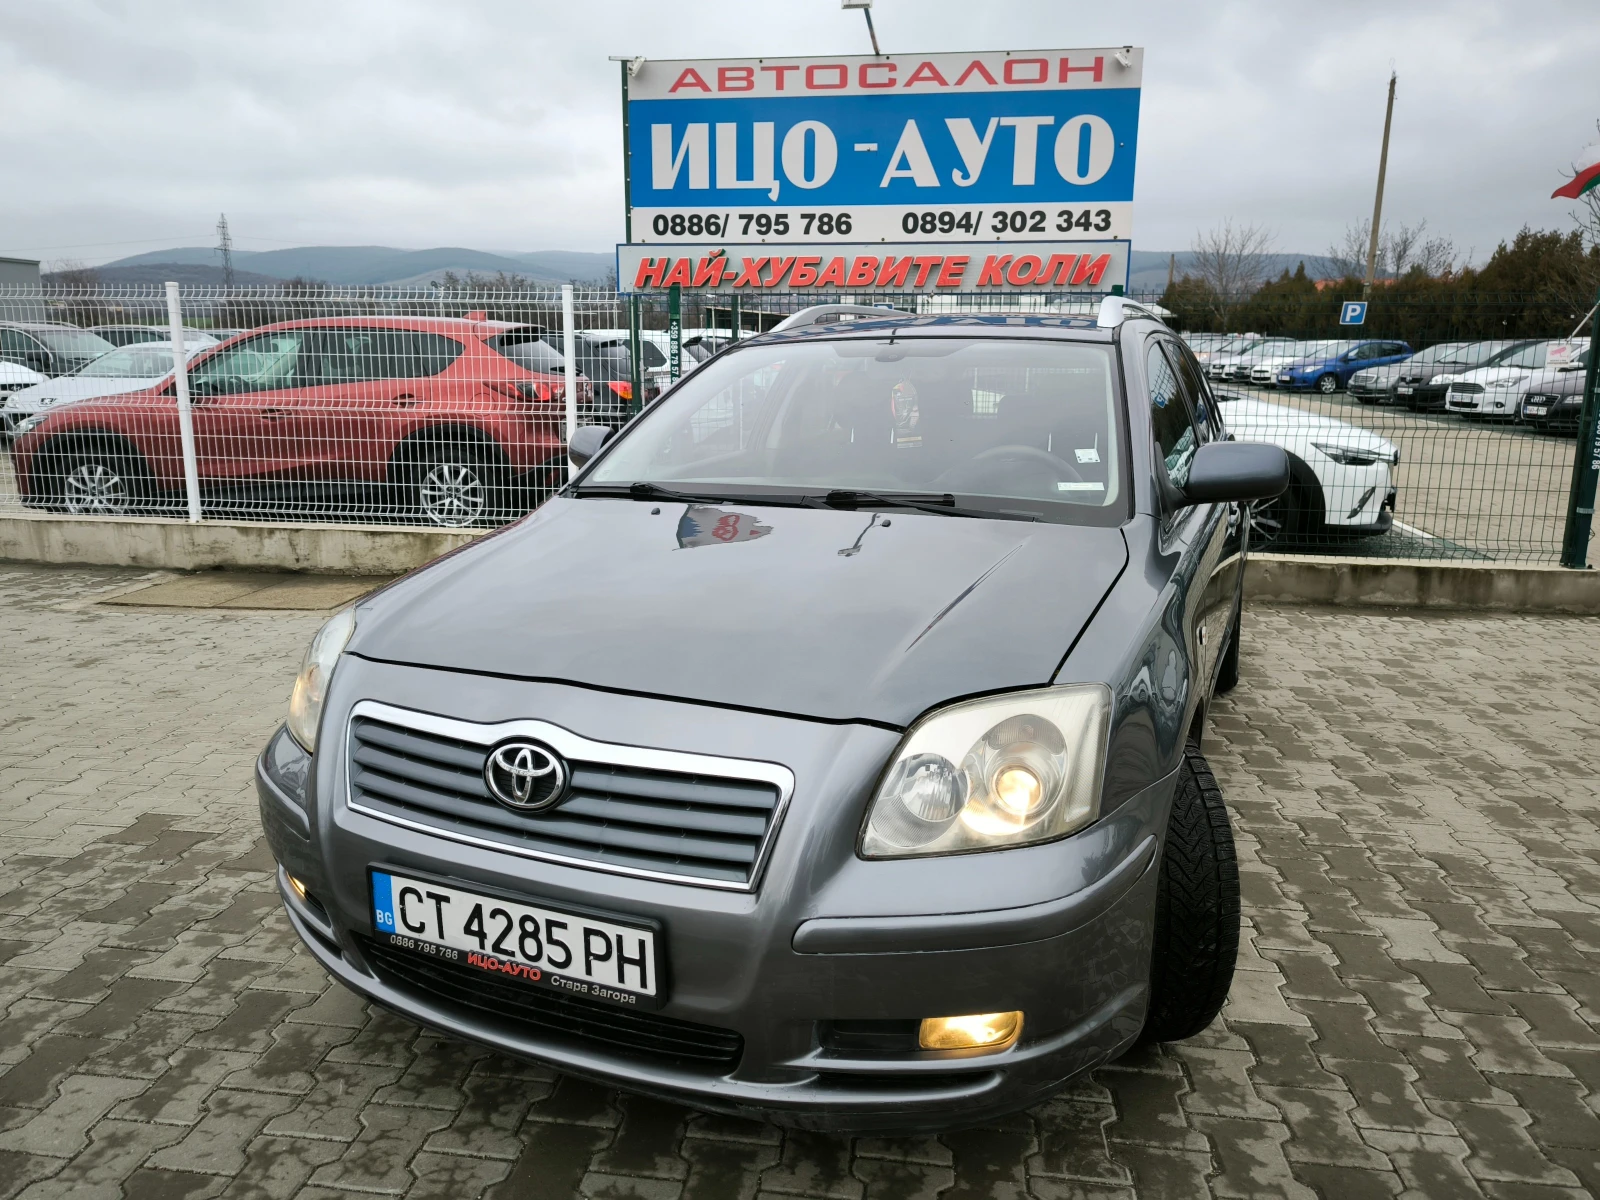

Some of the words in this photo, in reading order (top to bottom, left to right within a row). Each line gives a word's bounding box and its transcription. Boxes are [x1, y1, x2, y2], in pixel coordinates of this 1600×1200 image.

[668, 56, 1104, 93] АВТОСАЛОН
[652, 214, 730, 238] 0886/
[738, 213, 790, 236] 795
[800, 213, 853, 235] 786
[902, 211, 983, 235] 0894/
[991, 210, 1047, 233] 302
[1056, 209, 1112, 232] 343
[634, 248, 970, 288] НАЙ-ХУБАВИТЕ
[976, 253, 1112, 287] КОЛИ
[1345, 304, 1361, 321] P
[670, 321, 678, 339] +359
[671, 356, 678, 365] 79
[672, 366, 679, 375] 57
[1591, 459, 1600, 470] 86
[376, 909, 393, 925] BG
[399, 886, 451, 940] CT
[463, 902, 573, 970] 4285
[583, 926, 648, 990] PH
[390, 935, 415, 949] 0886
[418, 942, 437, 954] 795
[439, 947, 459, 960] 786
[467, 952, 541, 981] ИЦО-АУТО
[551, 975, 588, 993] Стара
[591, 985, 636, 1004] Загора
